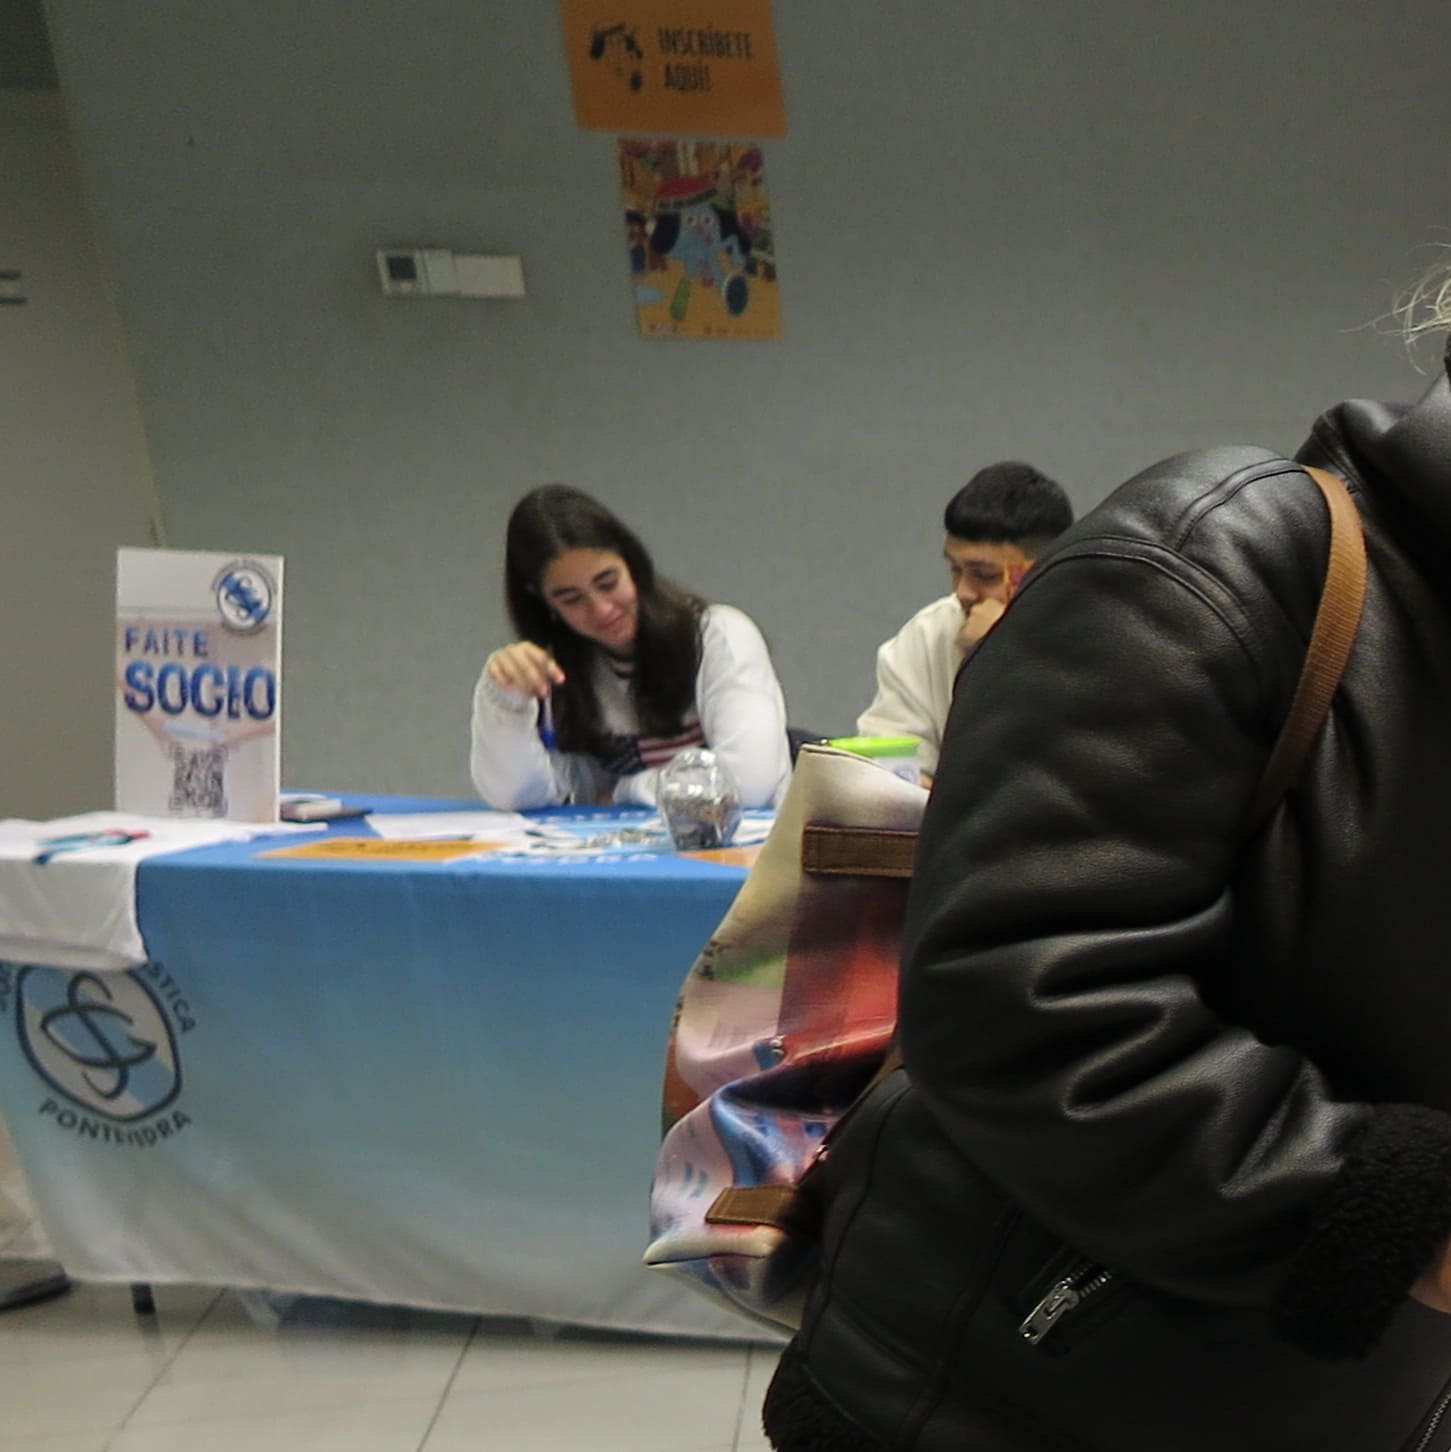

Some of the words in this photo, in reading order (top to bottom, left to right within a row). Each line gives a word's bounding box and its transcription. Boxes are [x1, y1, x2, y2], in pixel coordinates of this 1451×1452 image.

[124, 626, 209, 657] FAITE
[124, 660, 276, 720] SOCIO
[145, 962, 196, 1034] STICA
